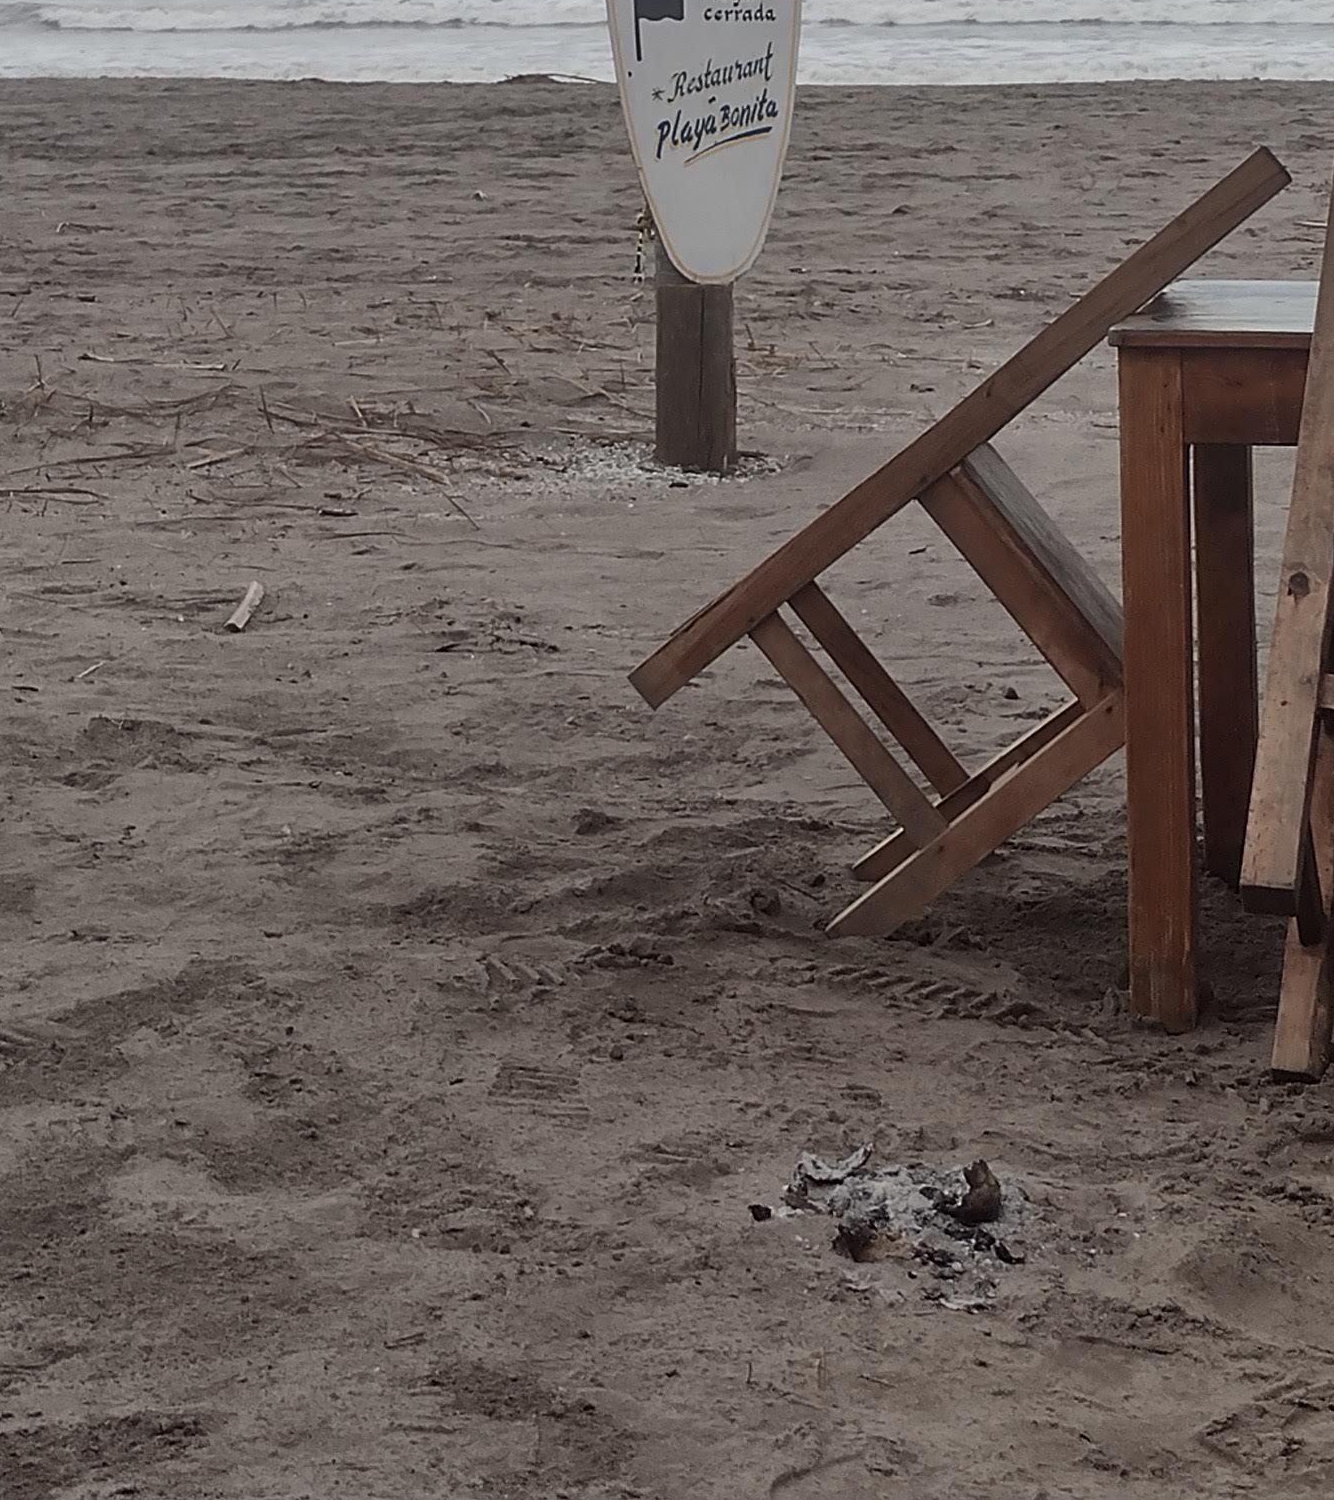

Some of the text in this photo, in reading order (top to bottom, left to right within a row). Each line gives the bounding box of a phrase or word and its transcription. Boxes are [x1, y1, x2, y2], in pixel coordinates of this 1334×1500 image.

[703, 2, 777, 22] cerrada
[667, 41, 774, 103] Restaurant
[655, 88, 779, 160] Playa Bonita
